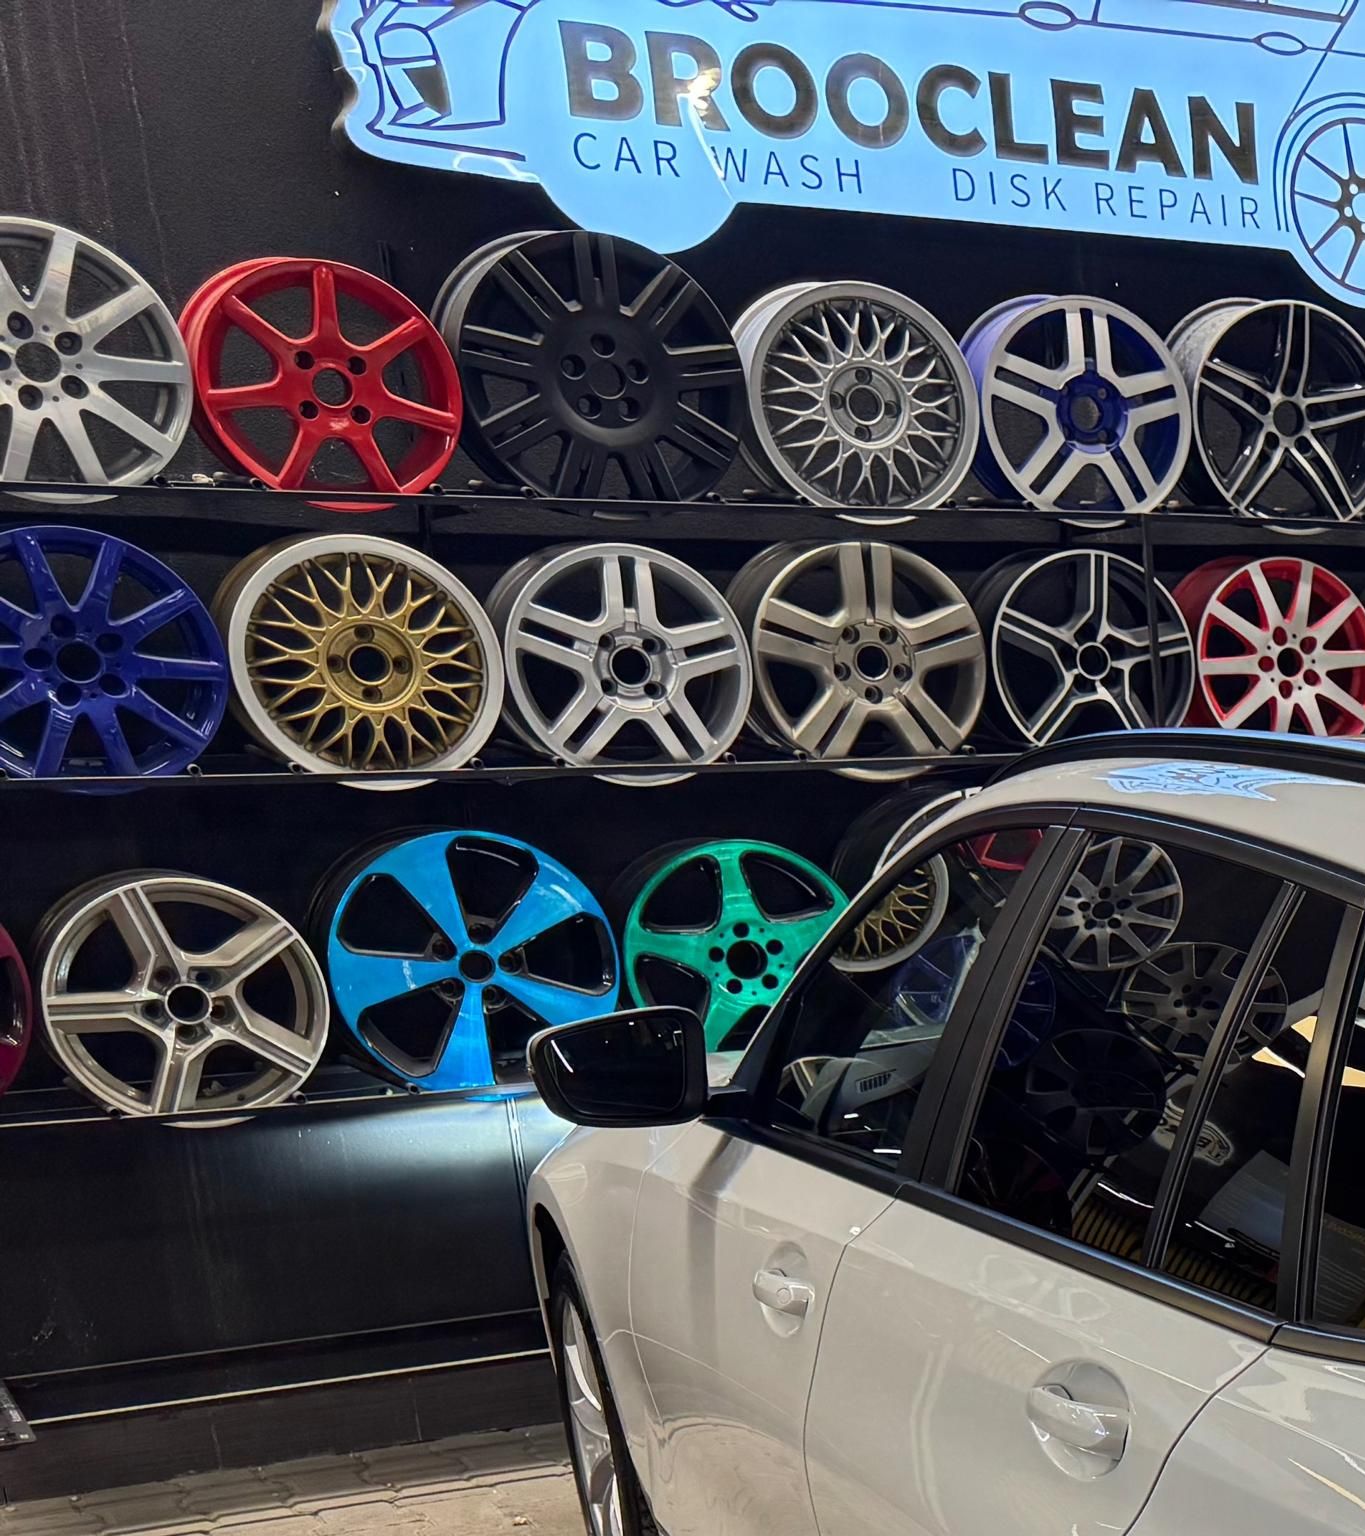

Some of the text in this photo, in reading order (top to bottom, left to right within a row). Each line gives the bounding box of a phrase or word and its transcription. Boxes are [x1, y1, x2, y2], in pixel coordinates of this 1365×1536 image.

[557, 19, 1259, 185] BROOCLEAN
[572, 132, 1261, 230] CAR WASH DISK REPAIR
